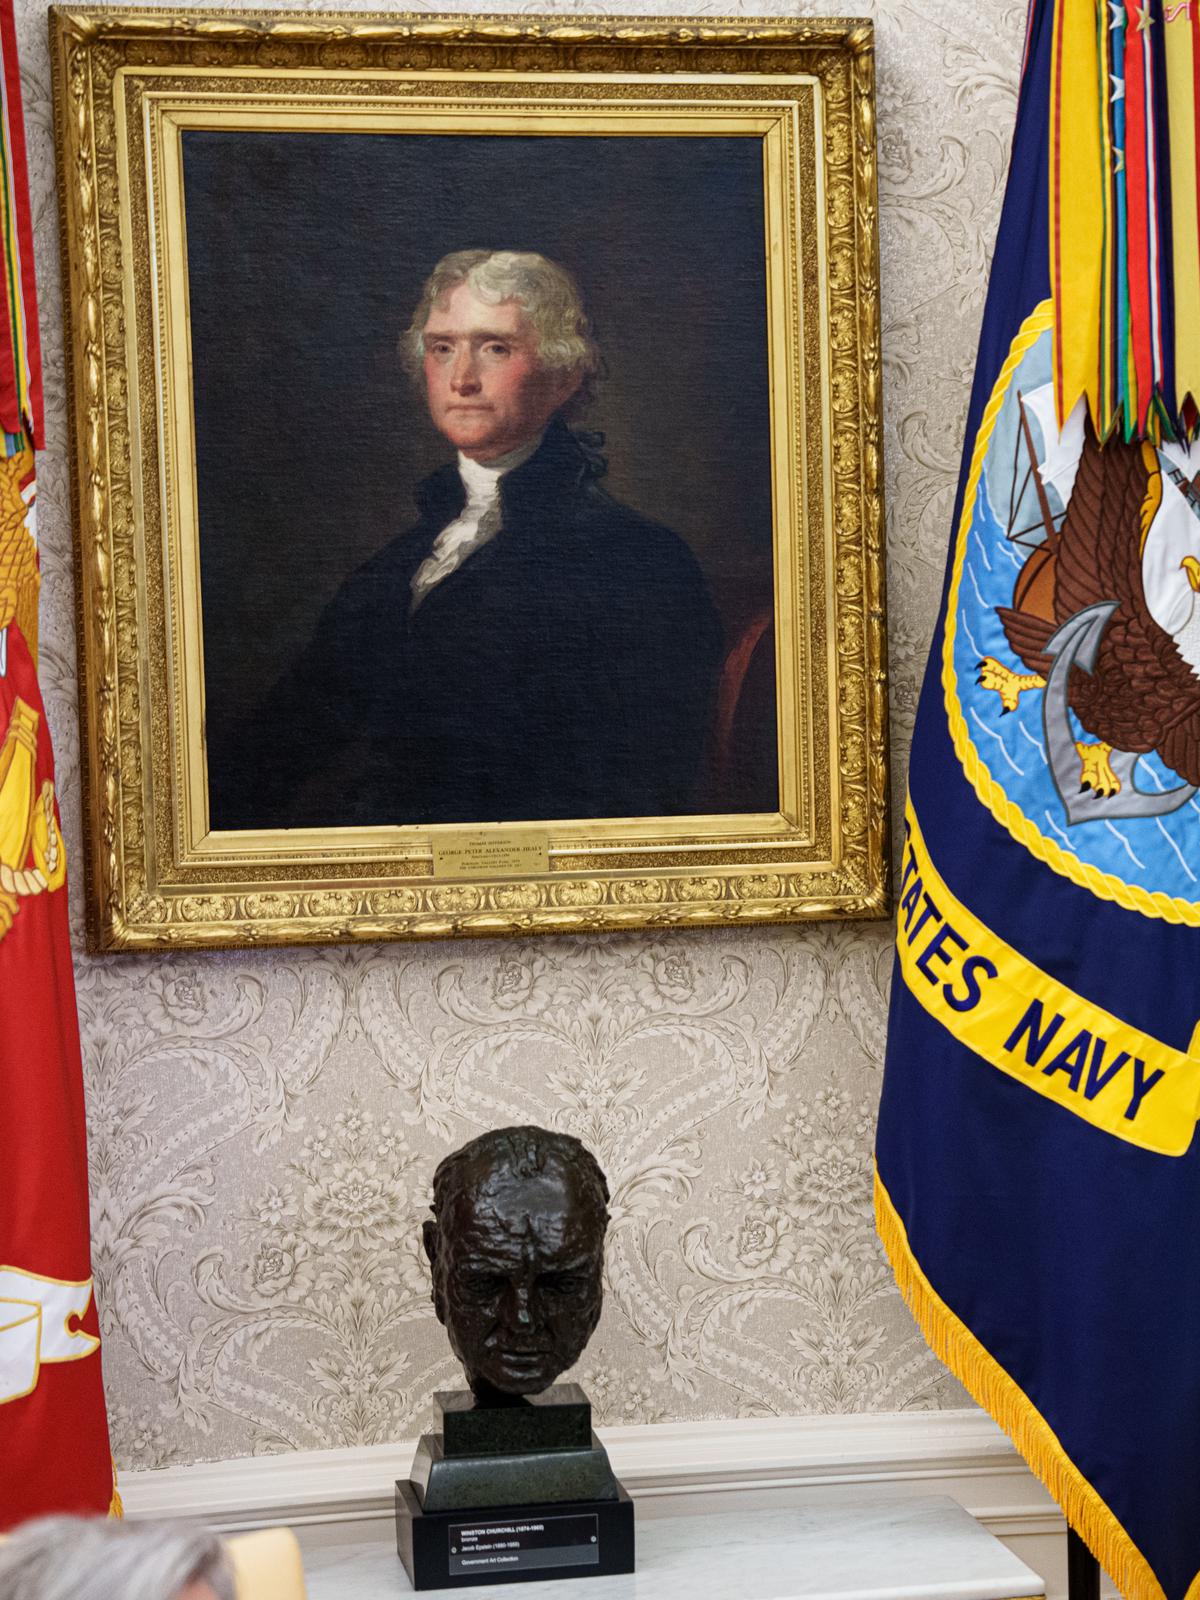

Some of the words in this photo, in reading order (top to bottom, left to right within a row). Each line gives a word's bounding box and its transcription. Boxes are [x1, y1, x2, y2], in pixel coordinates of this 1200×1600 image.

[1003, 998, 1165, 1121] NAVY
[486, 1527, 515, 1535] CHURCHILL
[497, 1555, 519, 1563] Collection
